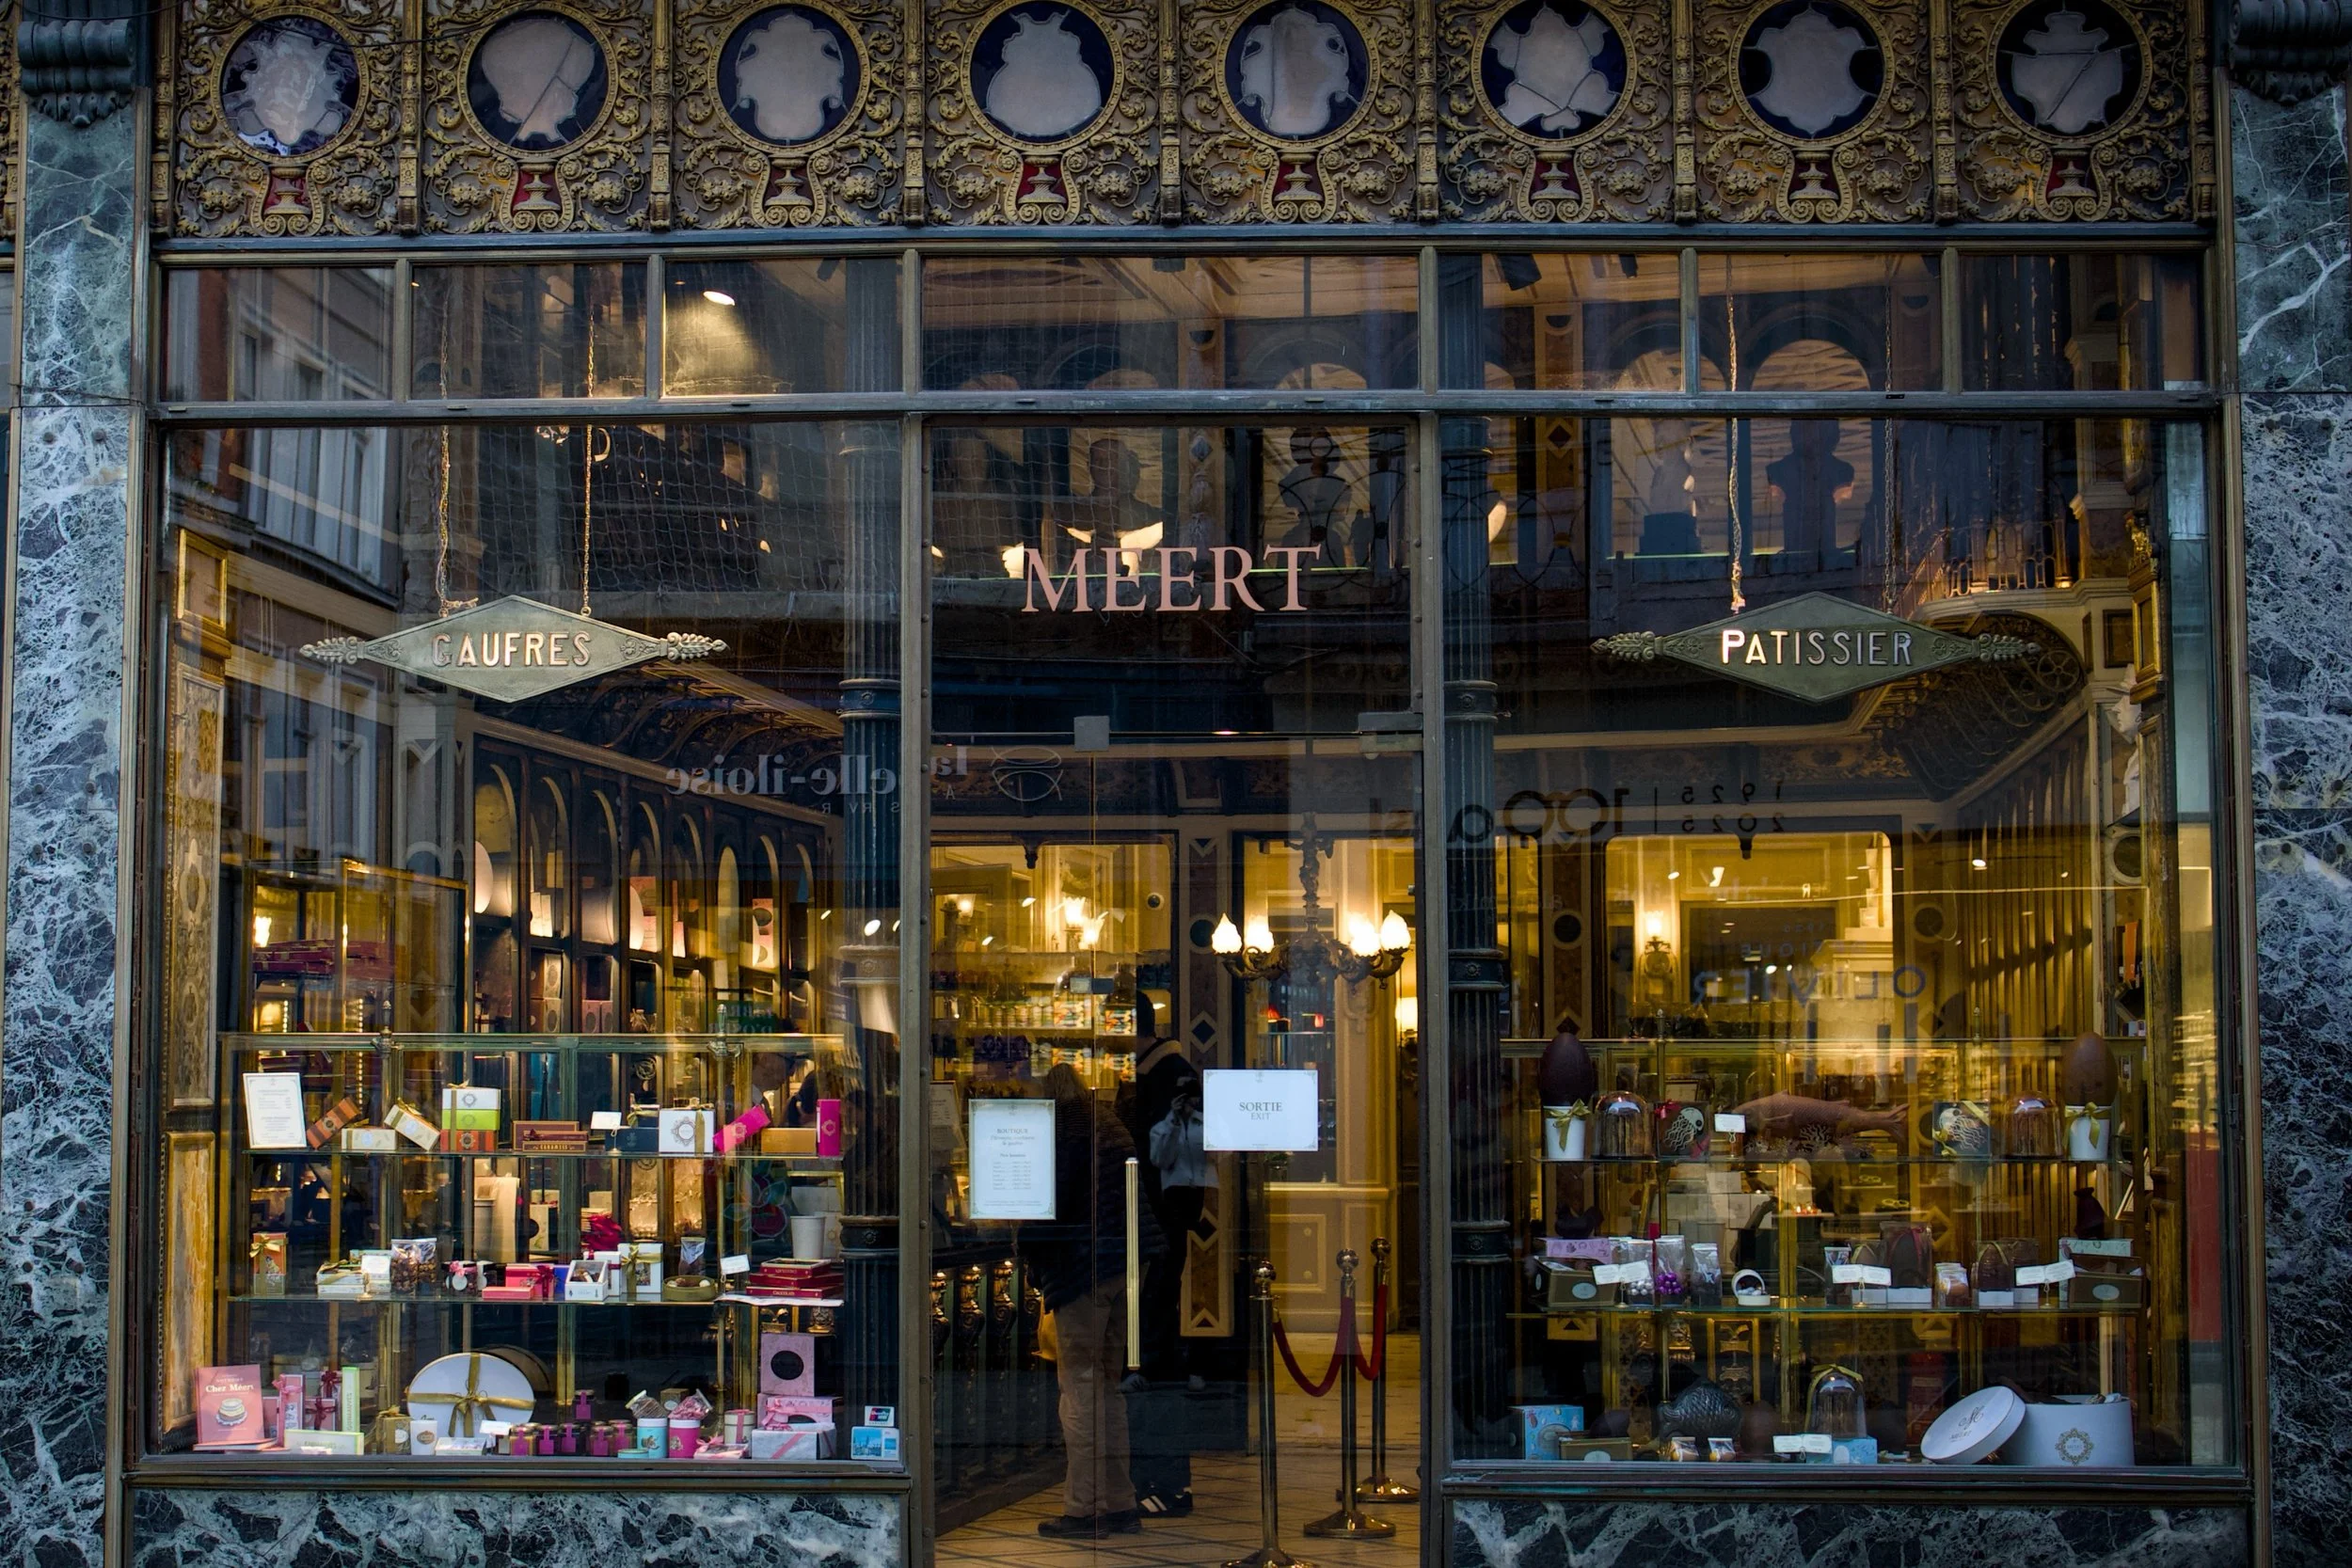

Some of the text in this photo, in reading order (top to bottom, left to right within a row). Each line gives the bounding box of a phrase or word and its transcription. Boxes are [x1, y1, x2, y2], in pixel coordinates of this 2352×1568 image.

[1022, 544, 1322, 612] MEERT
[432, 631, 591, 667] GAUFRES
[1722, 629, 1913, 666] PATISSIER
[1238, 1101, 1283, 1112] SORTIE
[1250, 1112, 1271, 1121] EXIT
